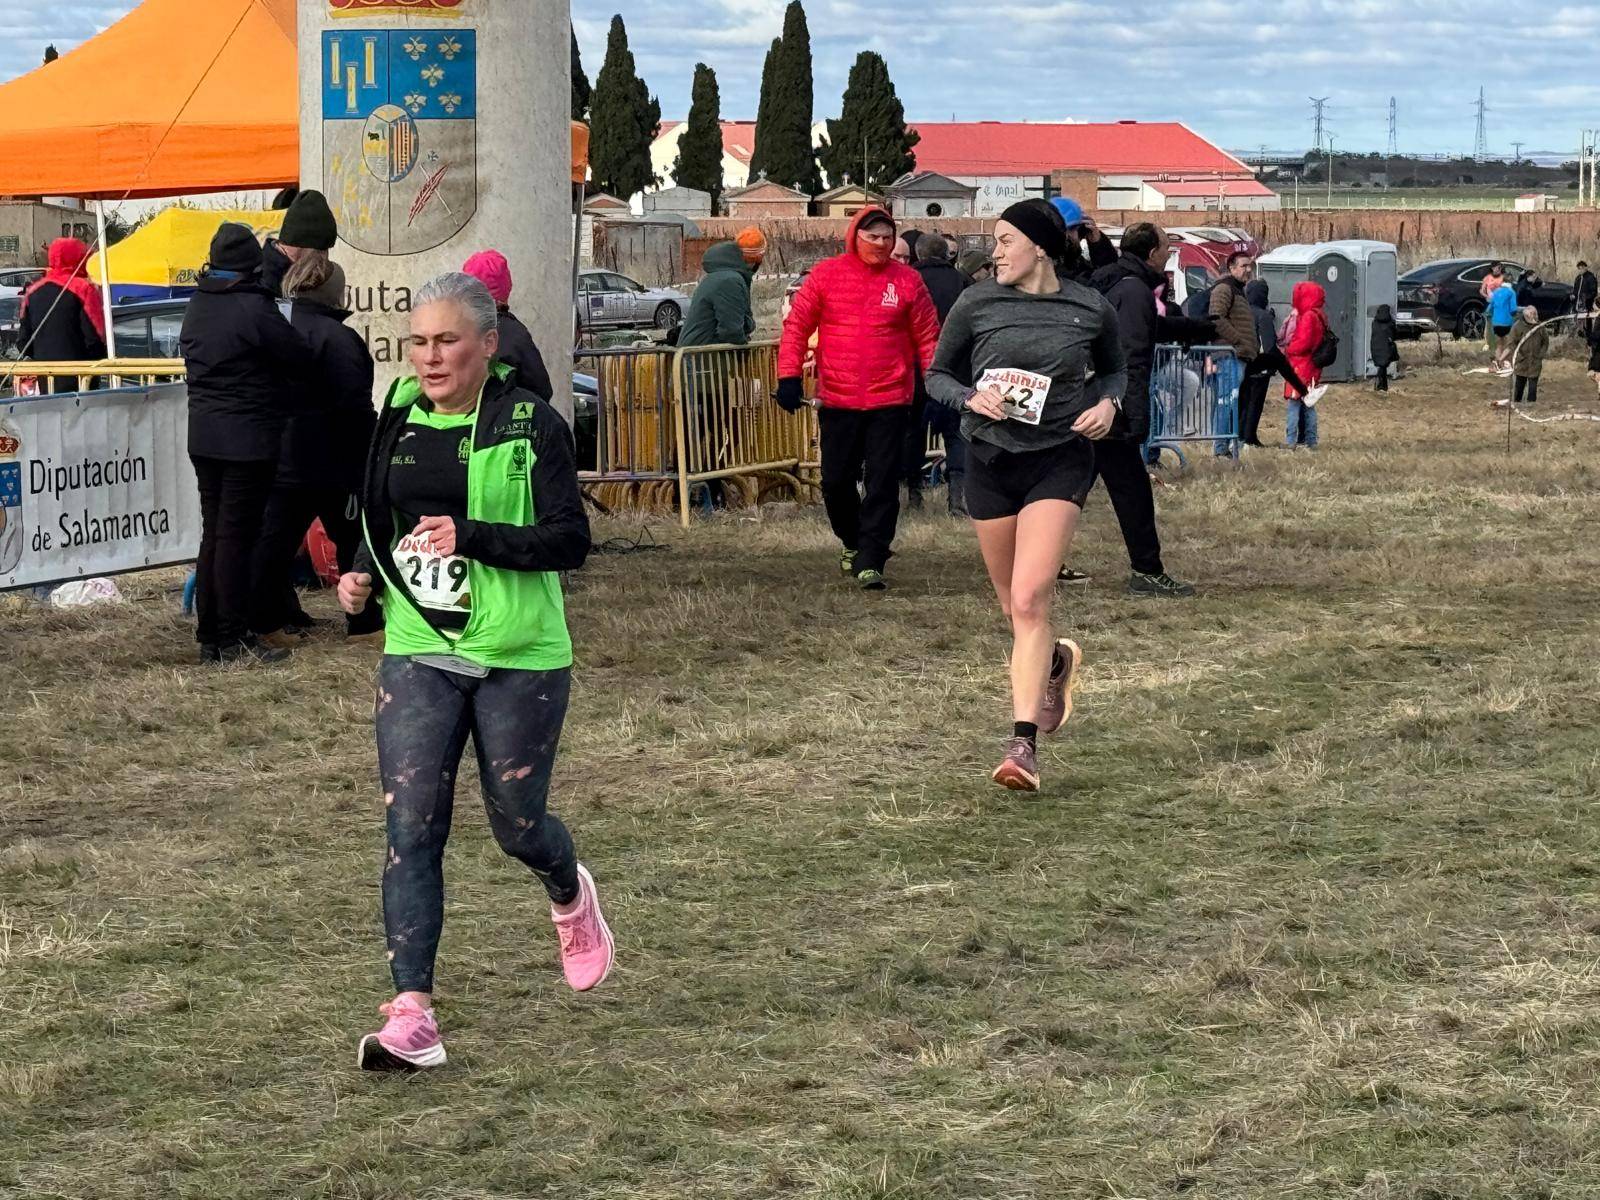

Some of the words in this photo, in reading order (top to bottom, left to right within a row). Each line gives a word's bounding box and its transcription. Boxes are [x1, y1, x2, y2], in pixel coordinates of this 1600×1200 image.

[30, 448, 146, 500] Diputación
[32, 525, 52, 551] de
[59, 508, 170, 548] Salamanca
[407, 556, 467, 592] 219
